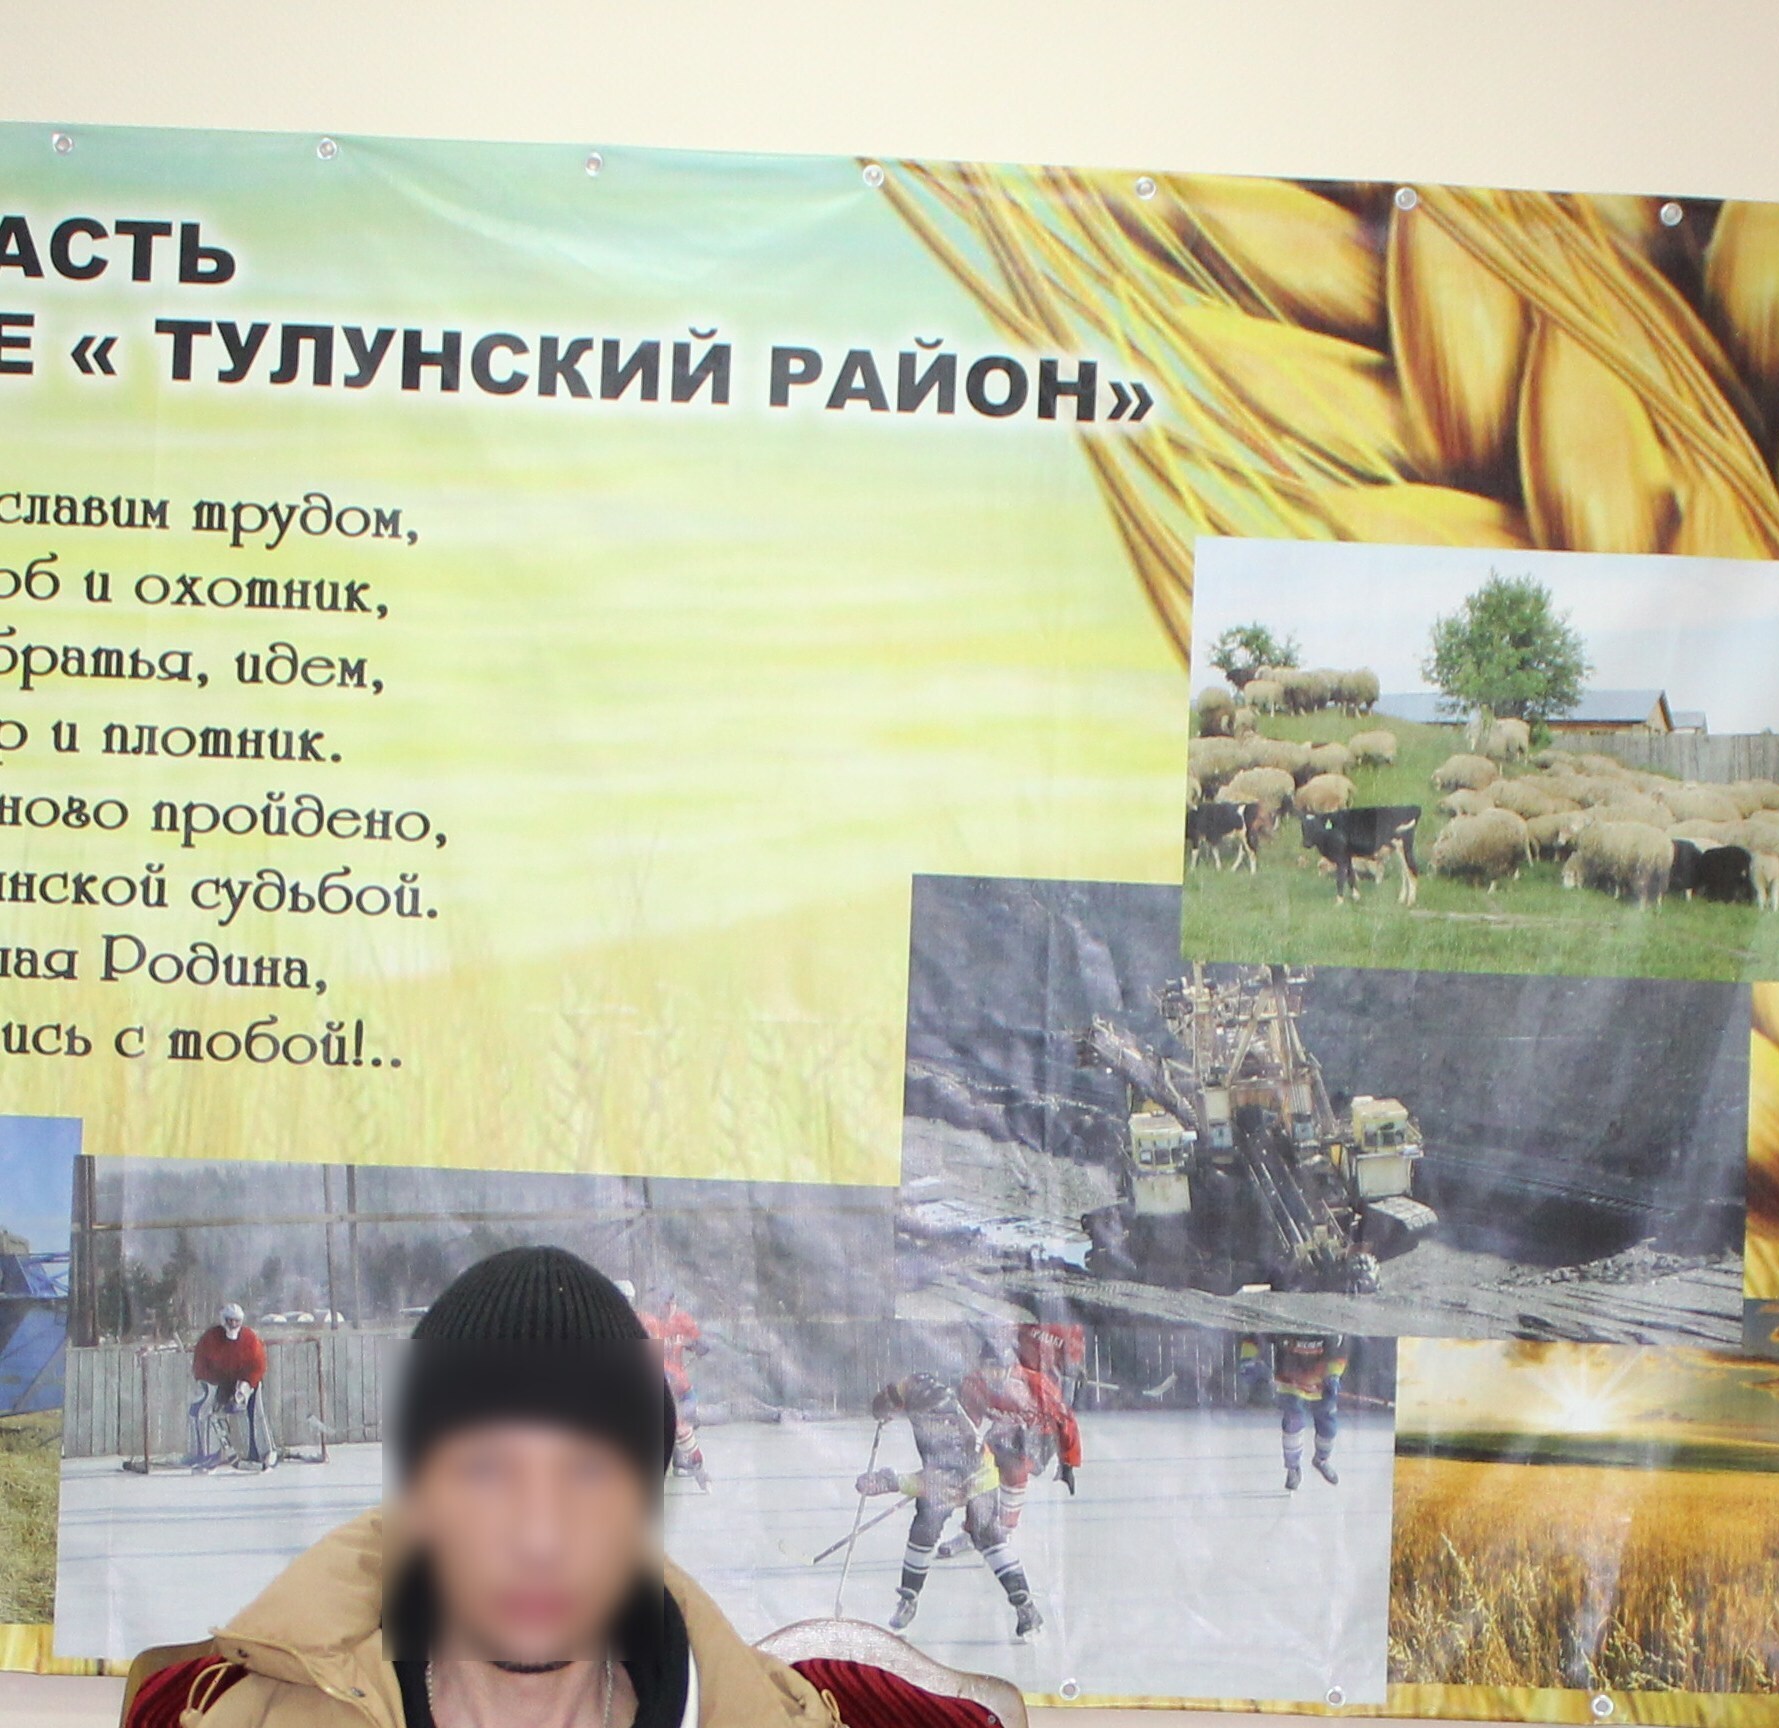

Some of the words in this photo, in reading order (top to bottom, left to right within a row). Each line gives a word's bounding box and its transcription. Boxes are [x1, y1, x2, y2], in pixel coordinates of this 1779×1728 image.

[0, 215, 236, 285] АСТЬ
[154, 319, 731, 404] ТУЛУНСКИЙ
[770, 339, 1153, 422] РАЙОН»
[192, 493, 417, 550] трудом,
[83, 570, 112, 603] и
[134, 574, 388, 619] охотник,
[235, 642, 383, 695] идем,
[51, 719, 80, 753] и
[102, 722, 341, 763] плотник.
[151, 792, 447, 849] пройдено,
[0, 863, 168, 908] нской
[191, 866, 438, 927] судьбой.
[100, 934, 327, 995] Родина,
[1, 1020, 92, 1057] ись
[114, 1026, 145, 1058] с
[167, 1015, 402, 1068] тобой!..
